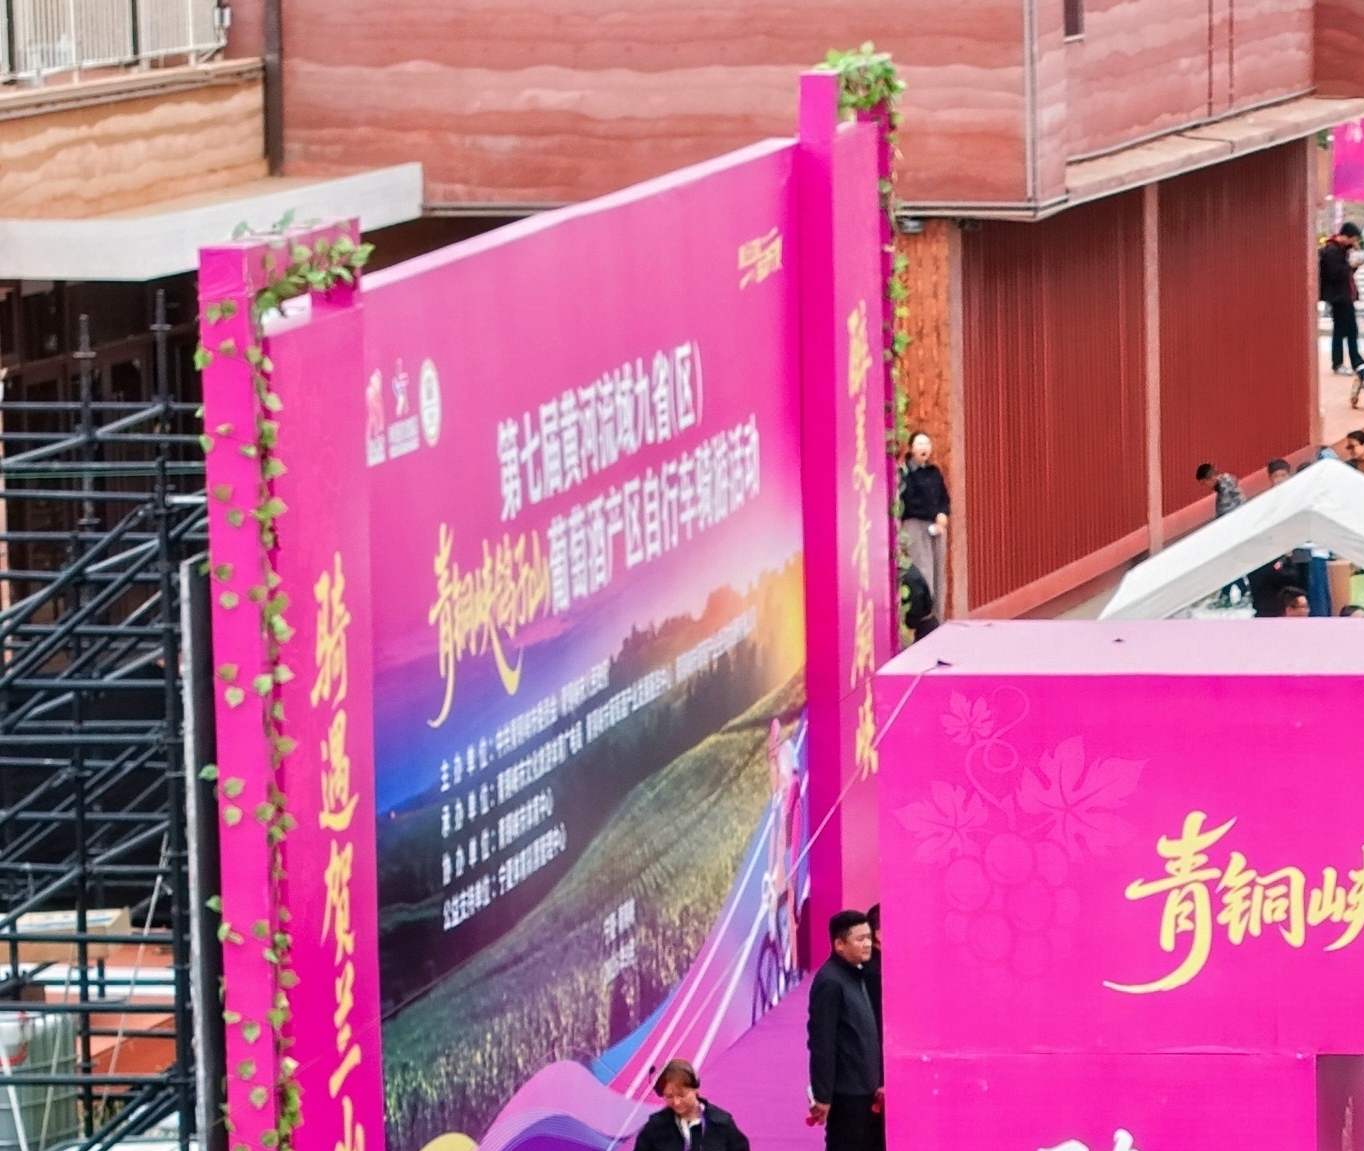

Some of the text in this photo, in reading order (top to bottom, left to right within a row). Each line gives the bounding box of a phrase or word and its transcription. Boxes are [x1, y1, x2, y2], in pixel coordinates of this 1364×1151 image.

[497, 340, 704, 522] 第七届黄河流域九省(区)
